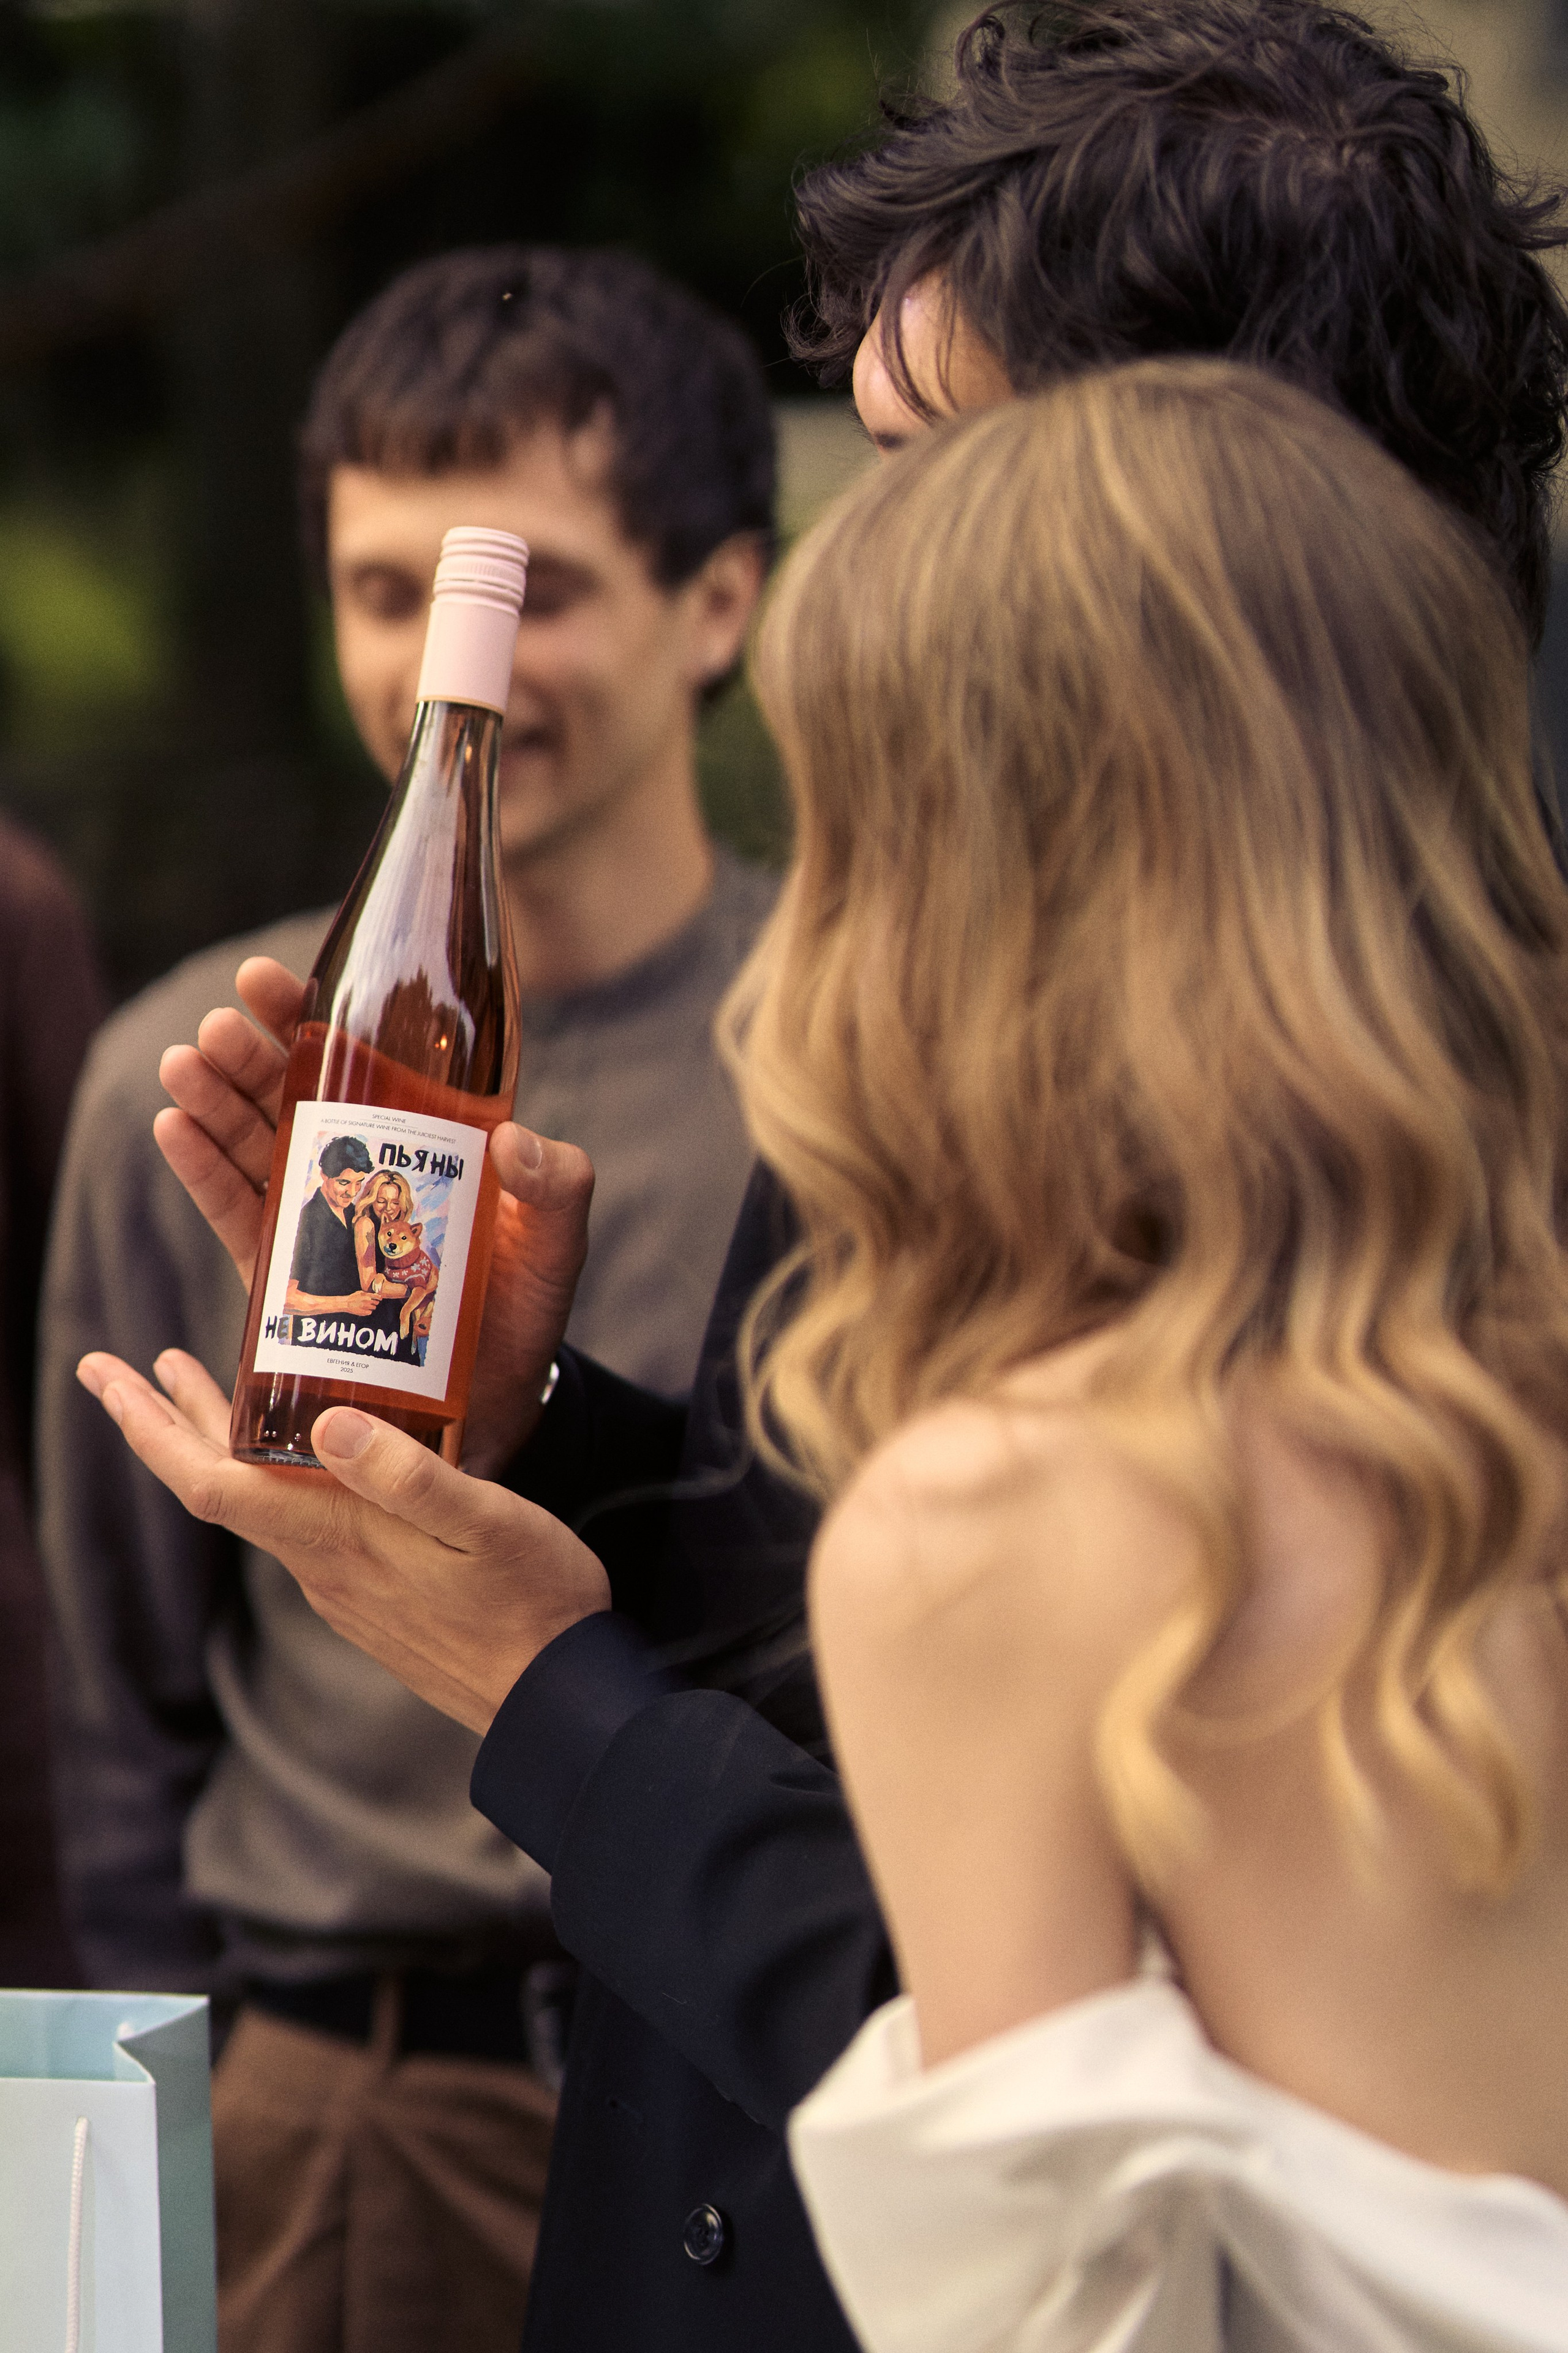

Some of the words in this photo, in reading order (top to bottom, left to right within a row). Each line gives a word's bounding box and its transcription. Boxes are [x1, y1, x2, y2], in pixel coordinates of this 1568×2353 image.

[417, 1131, 437, 1139] JUICIEST
[437, 1135, 456, 1144] HARVEST
[379, 1143, 464, 1180] ПЬЯНЫ
[265, 1315, 290, 1339] НЕ
[297, 1317, 399, 1356] ВИНОМ
